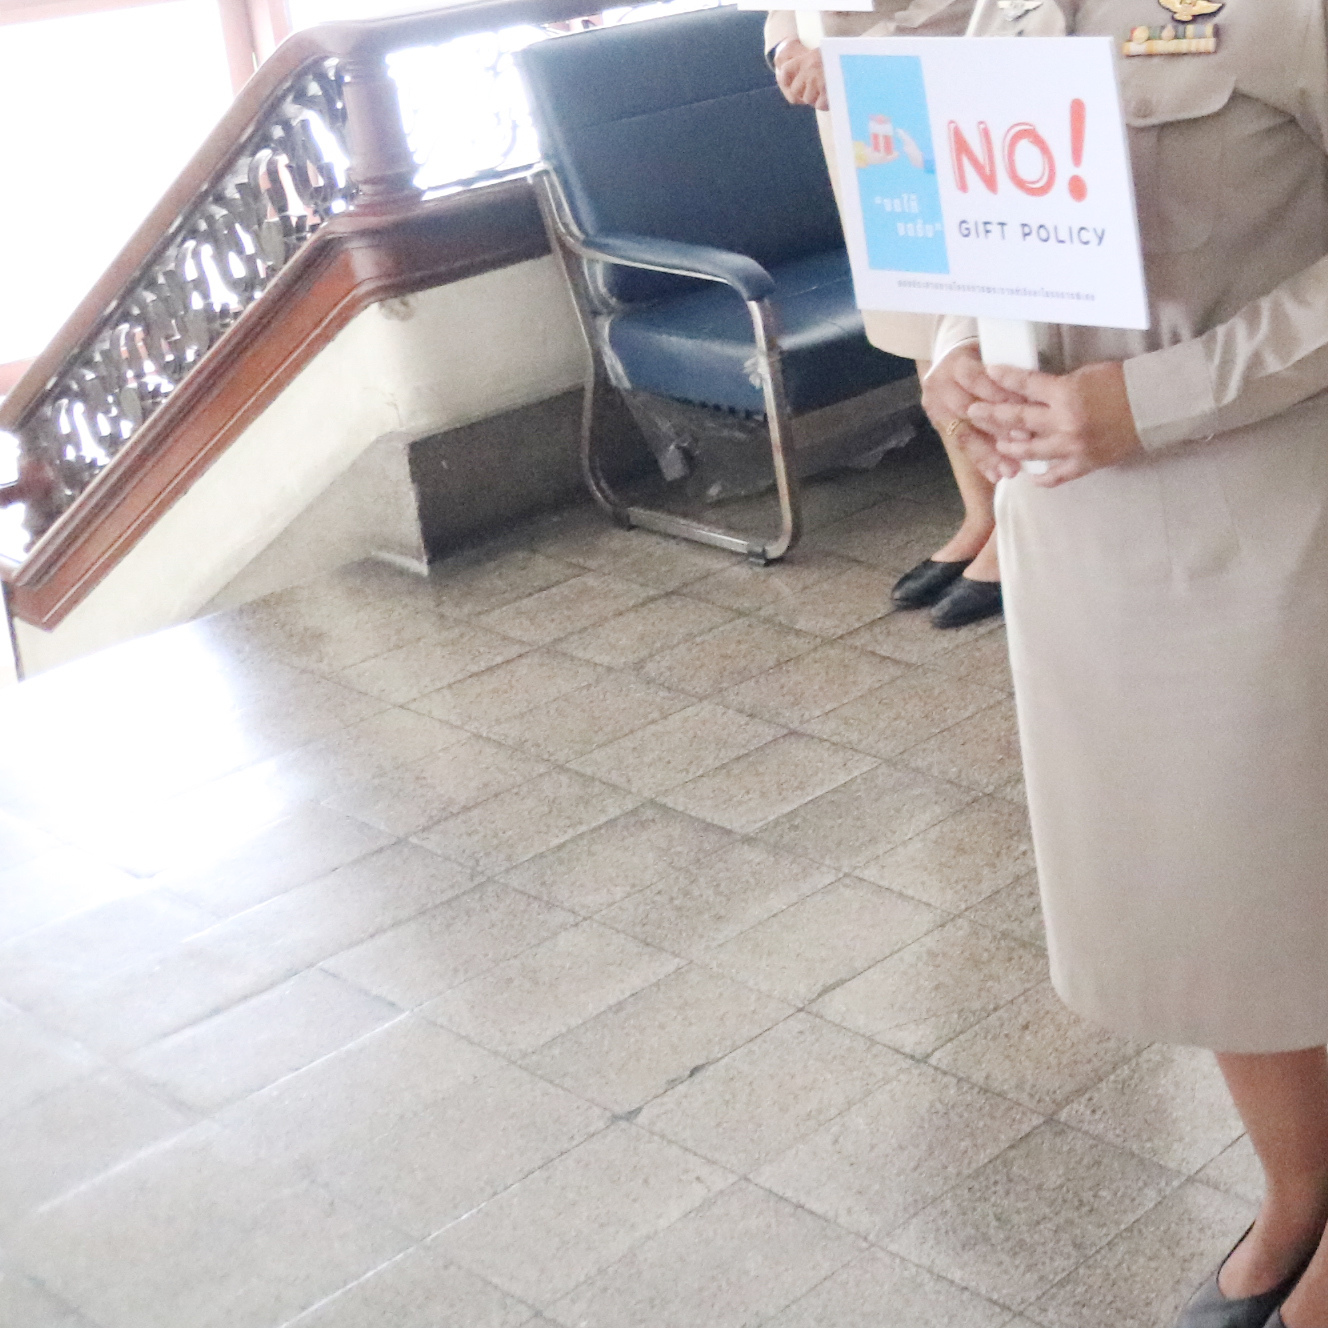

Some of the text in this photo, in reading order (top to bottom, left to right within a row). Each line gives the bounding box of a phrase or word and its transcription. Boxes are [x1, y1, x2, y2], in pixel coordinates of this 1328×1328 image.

[947, 98, 1087, 202] NO!
[958, 219, 1106, 247] GIFT POLICY
